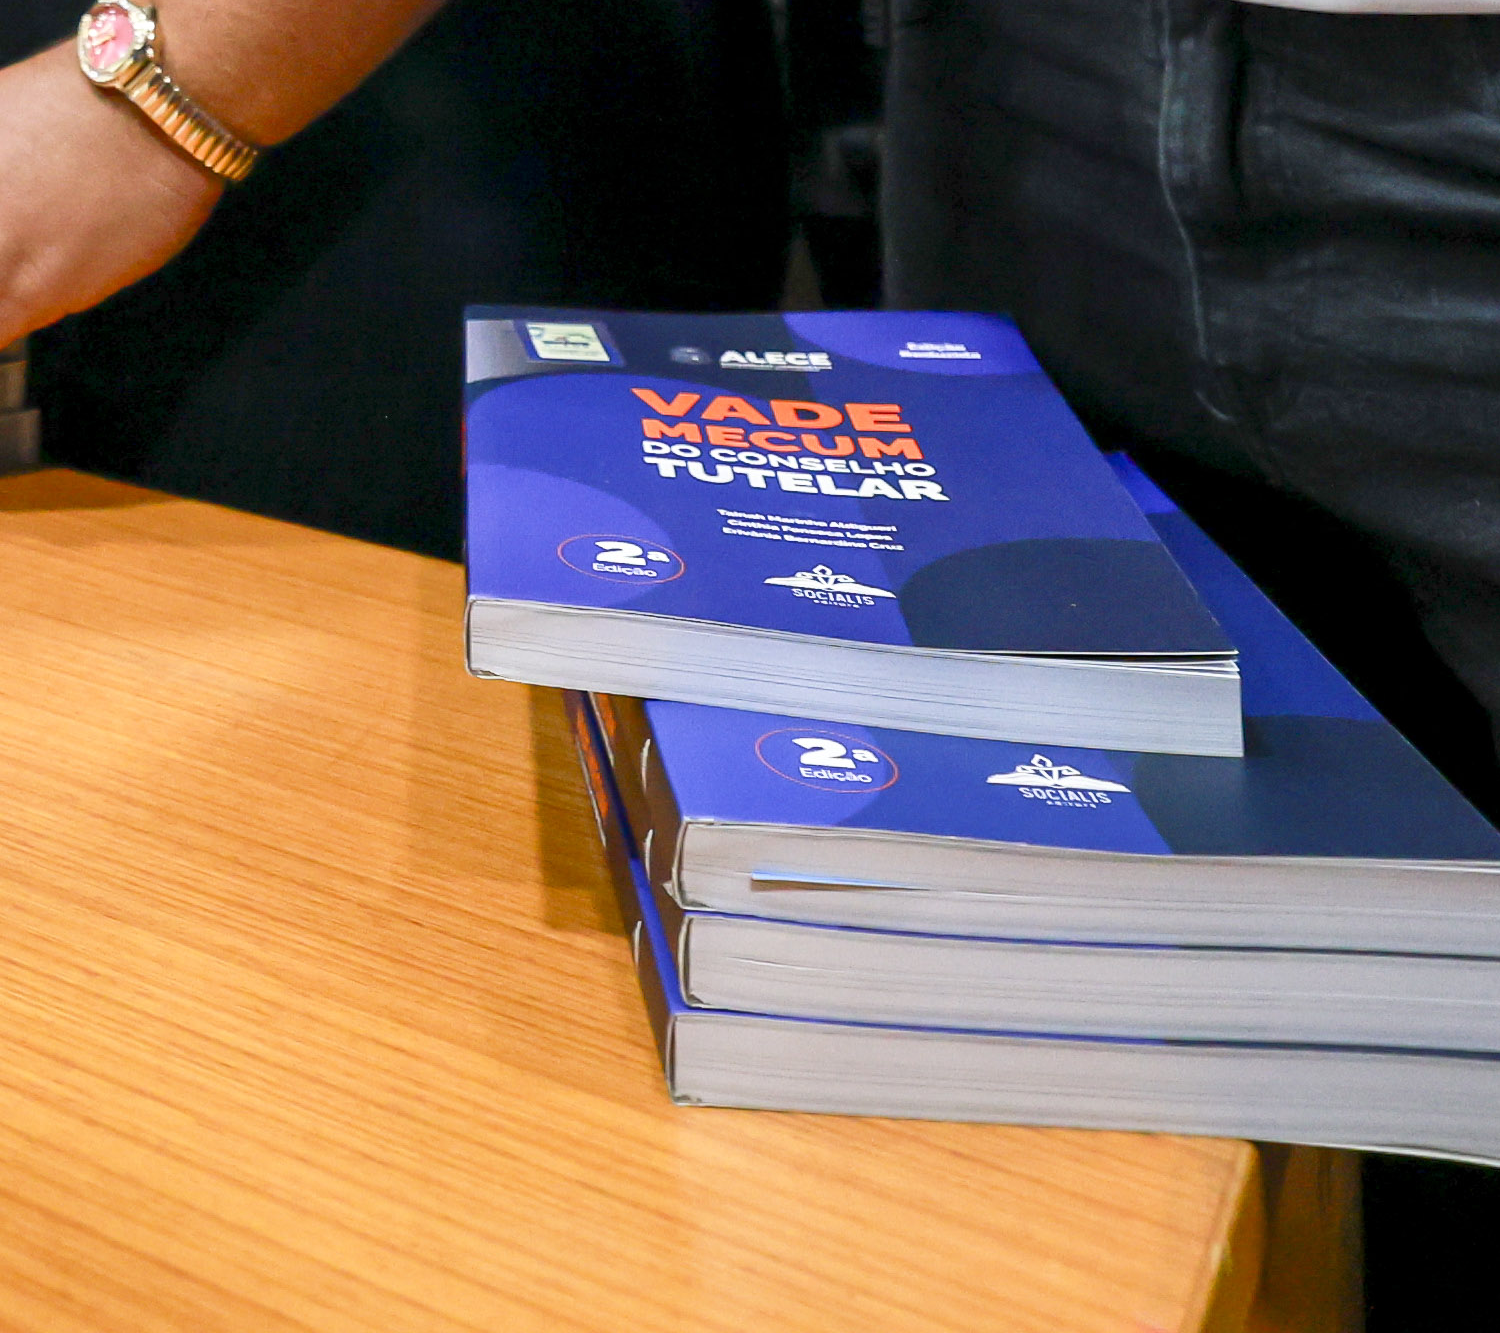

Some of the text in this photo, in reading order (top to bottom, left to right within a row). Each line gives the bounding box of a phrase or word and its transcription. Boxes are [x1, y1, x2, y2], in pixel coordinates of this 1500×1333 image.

[719, 350, 832, 366] ALECE
[631, 387, 912, 433] VADE
[641, 418, 924, 460] MECUM
[643, 440, 937, 477] DO CONSELHO
[643, 456, 951, 501] TUTELAR
[592, 562, 658, 579] Edição
[791, 588, 876, 606] SOCIALIS
[799, 767, 873, 784] Edição
[1017, 786, 1112, 806] SOCIALIS
